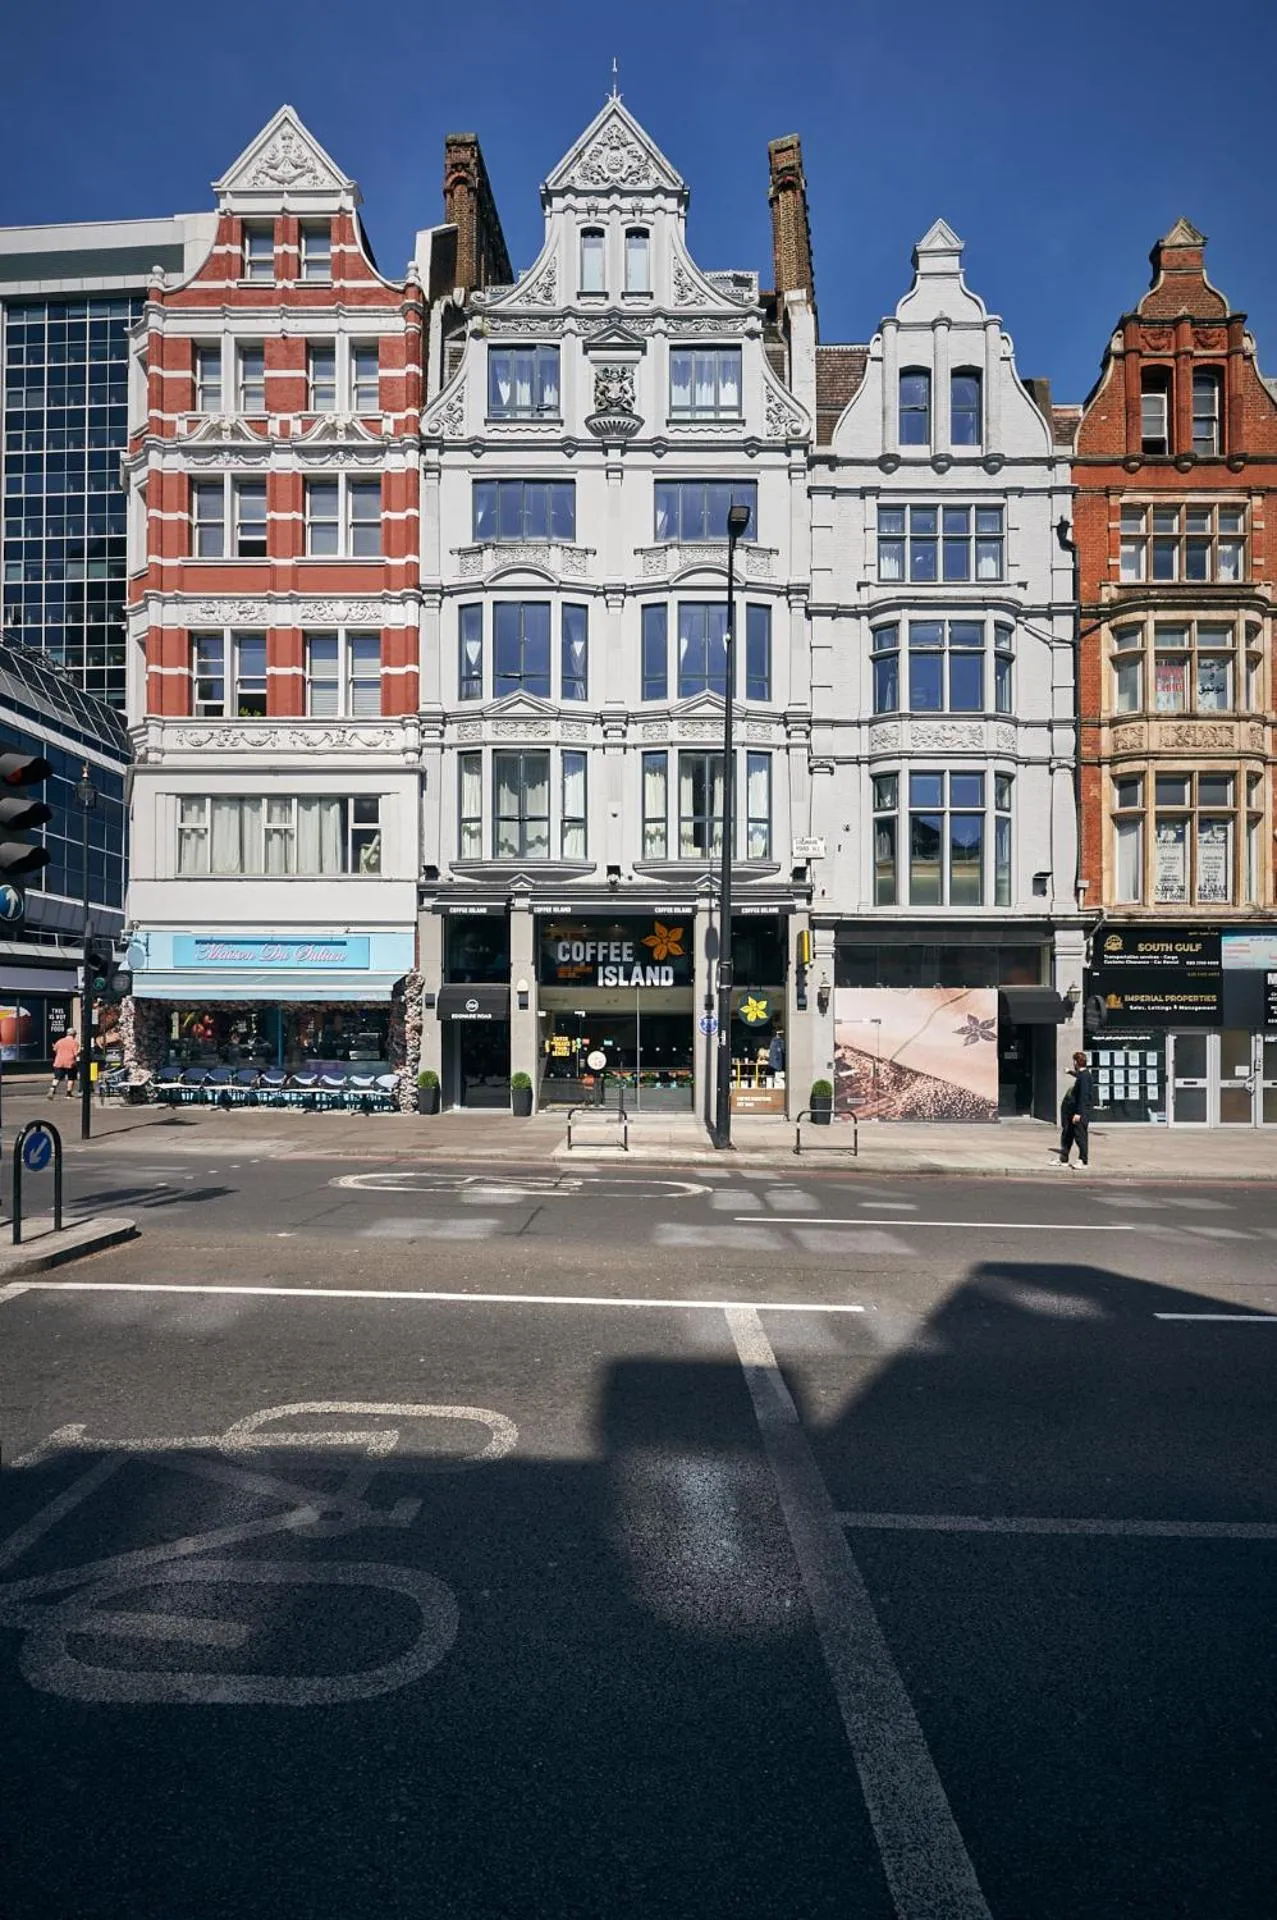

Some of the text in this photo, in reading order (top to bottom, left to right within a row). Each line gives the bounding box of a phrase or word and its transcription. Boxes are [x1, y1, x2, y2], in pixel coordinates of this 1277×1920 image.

[196, 943, 256, 961] Maison
[557, 941, 634, 962] COFFEE
[1137, 943, 1202, 952] SOUTH GULF
[597, 965, 674, 987] ISLAND
[1124, 994, 1217, 1002] IMPERIAL PROPERTIES
